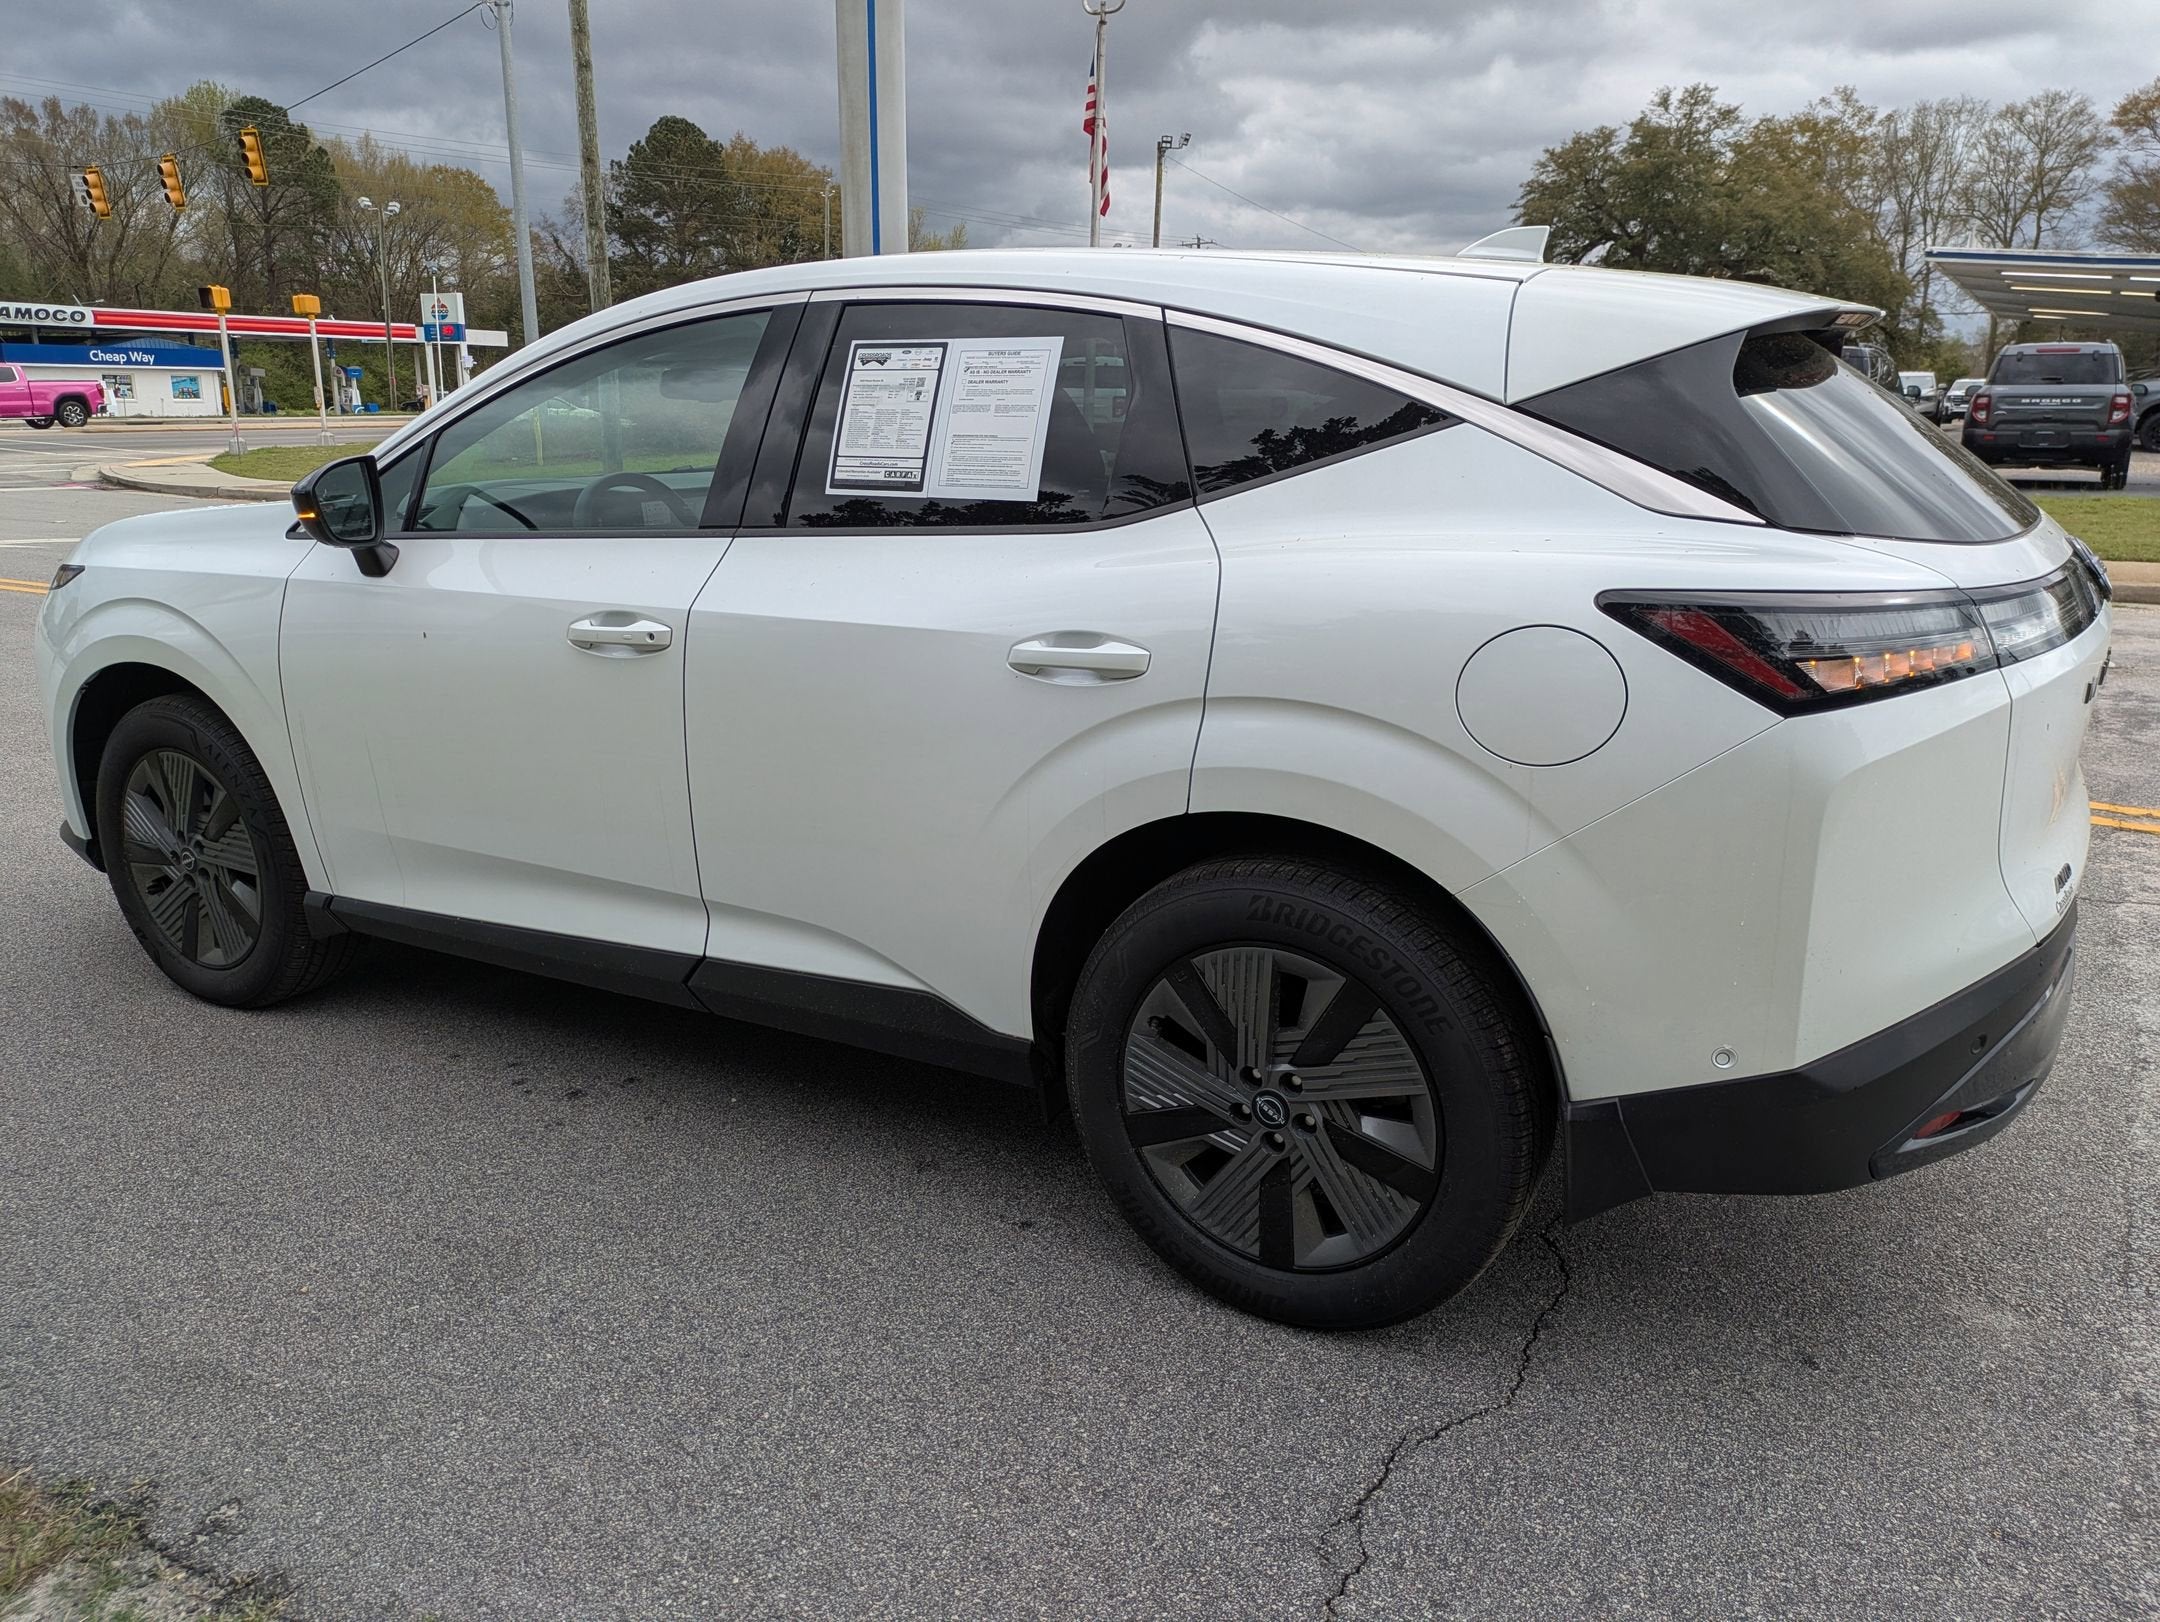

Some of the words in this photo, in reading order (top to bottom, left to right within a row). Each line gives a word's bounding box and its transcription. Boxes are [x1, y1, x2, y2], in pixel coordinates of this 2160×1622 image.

[0, 306, 86, 322] AMOCO
[89, 350, 127, 364] Cheap
[129, 351, 155, 365] Way
[884, 470, 919, 479] CARFAX
[1246, 894, 1454, 1037] BRIDGESTONE
[1255, 1097, 1285, 1125] NISSAN
